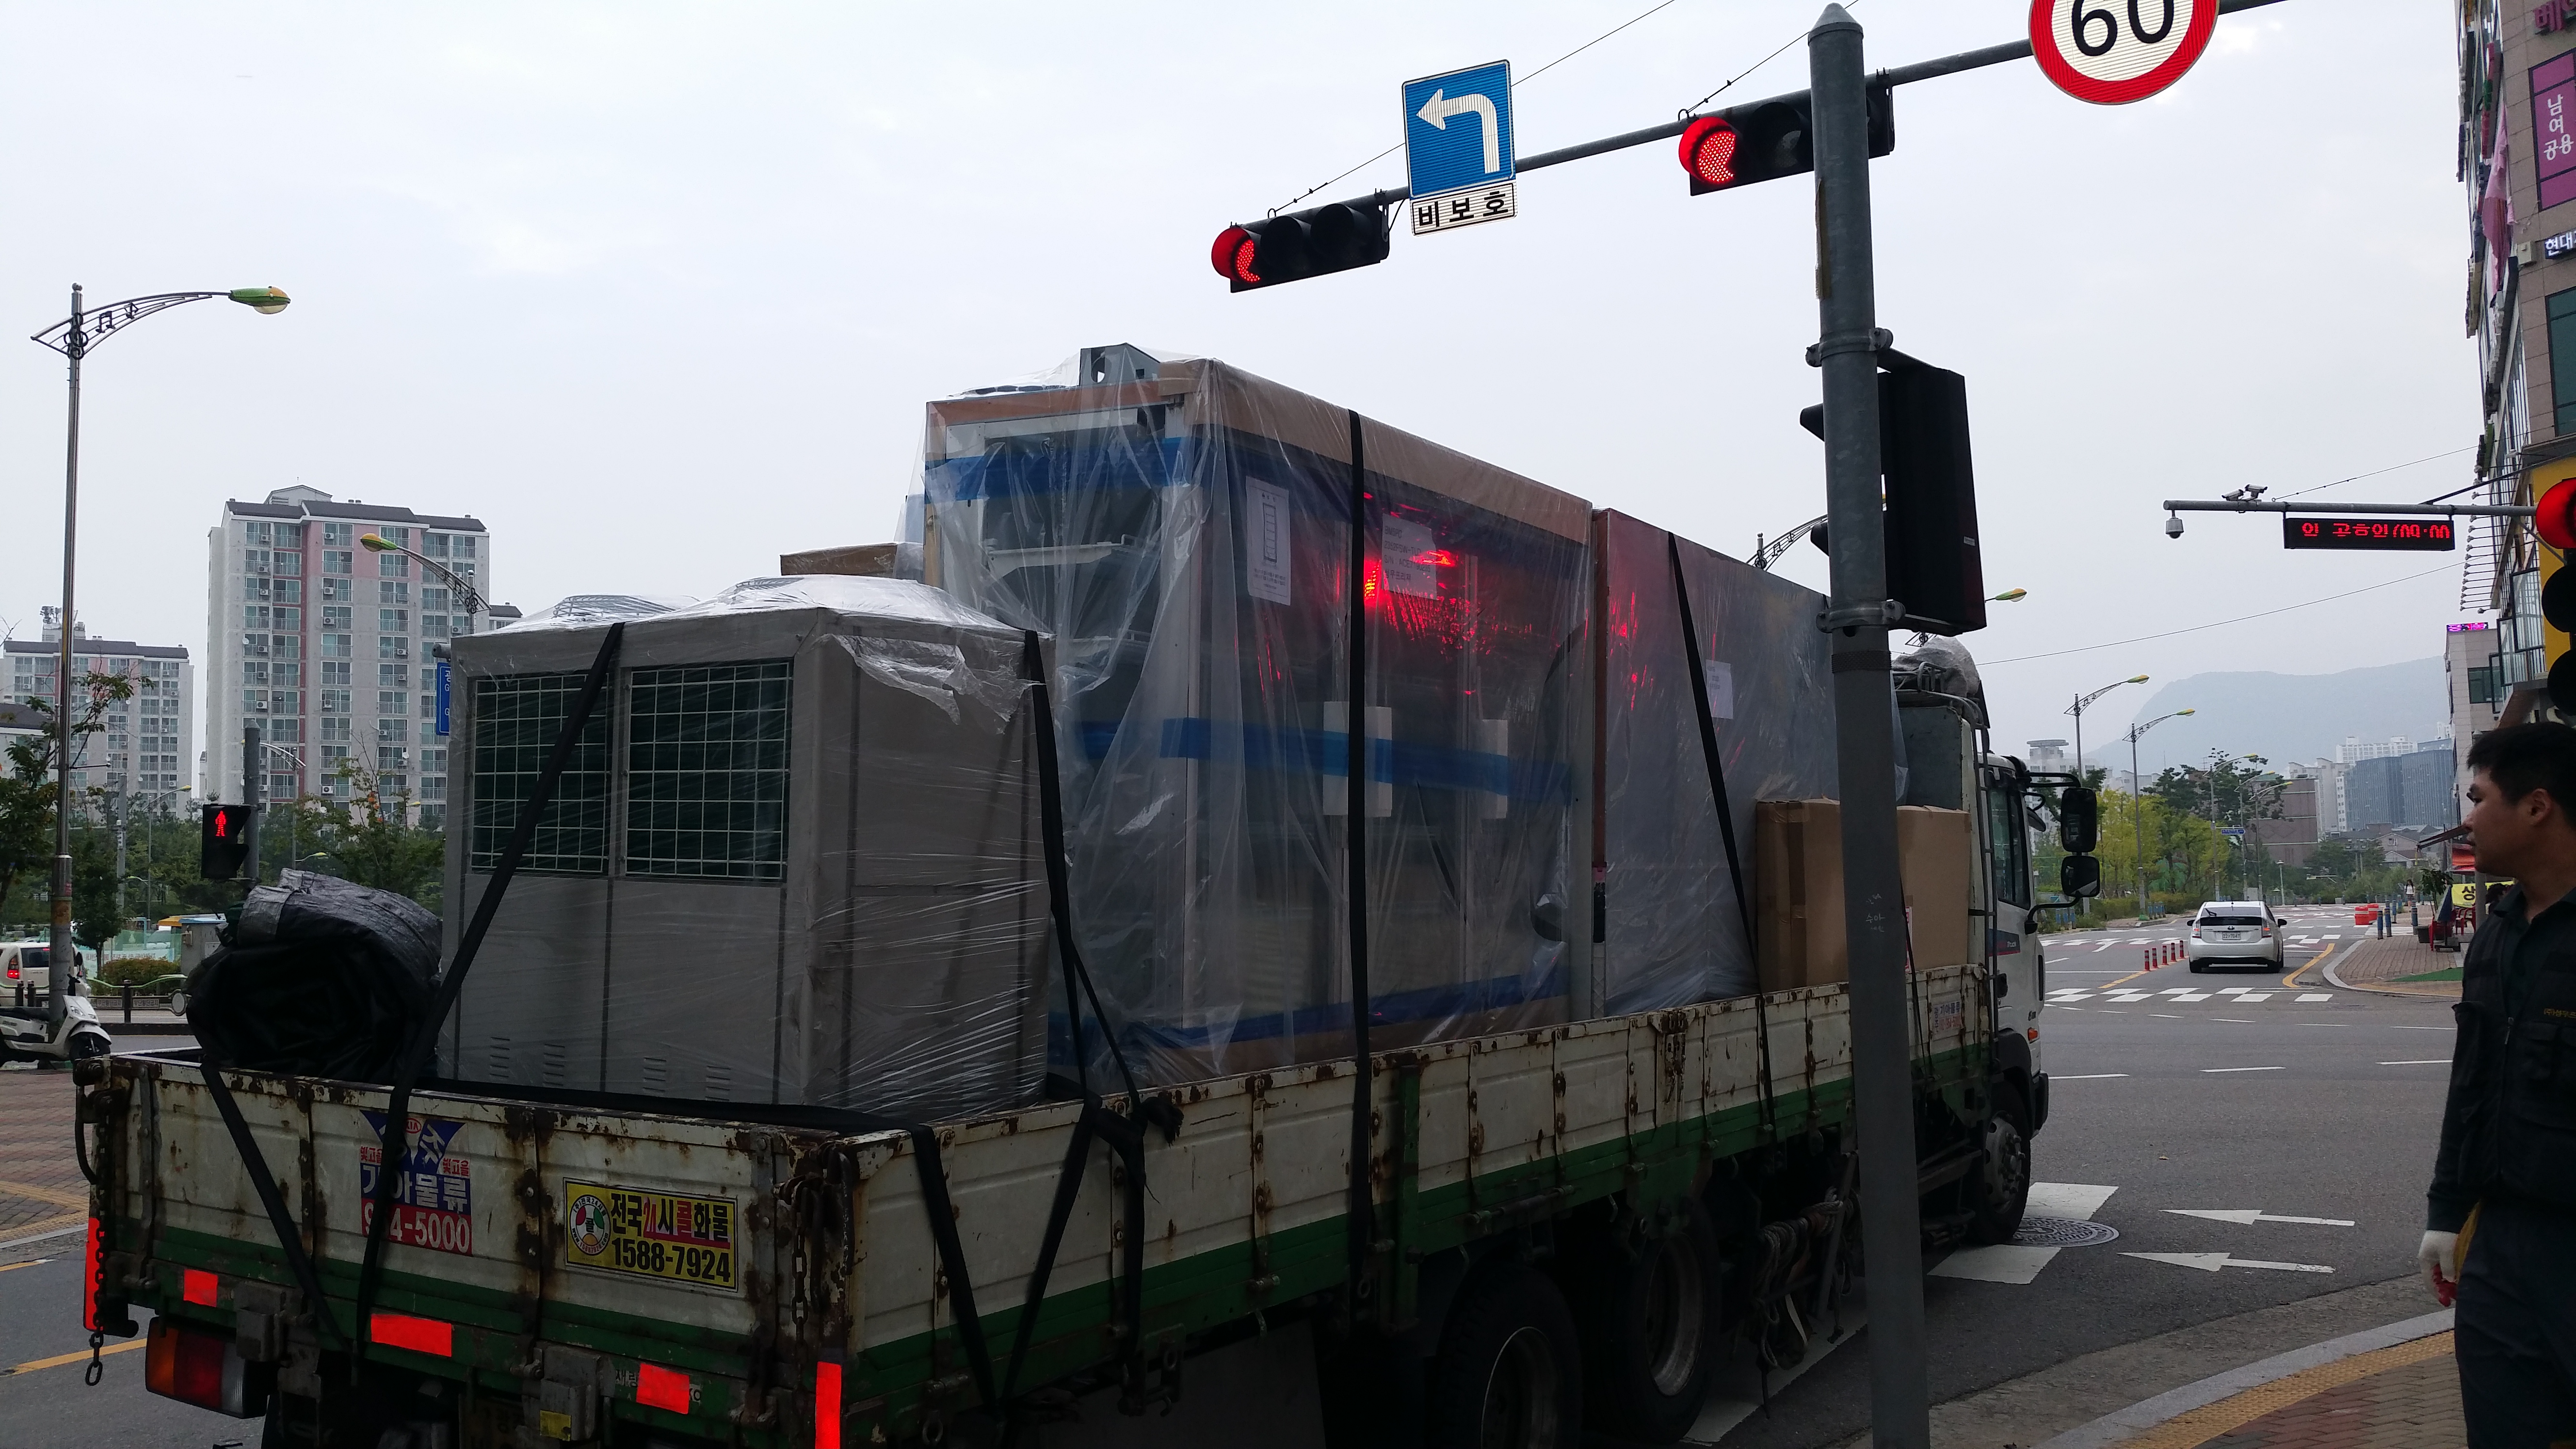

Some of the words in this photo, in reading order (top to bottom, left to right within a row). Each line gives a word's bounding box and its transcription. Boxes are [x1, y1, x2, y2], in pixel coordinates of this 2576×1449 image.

[2072, 0, 2174, 57] 60
[1418, 191, 1509, 227] 비보호
[442, 1158, 469, 1177] 빛고을
[364, 1202, 470, 1254] 94-5000
[611, 1193, 728, 1242] 전국24시콜화물
[612, 1238, 731, 1284] 1588-7924
